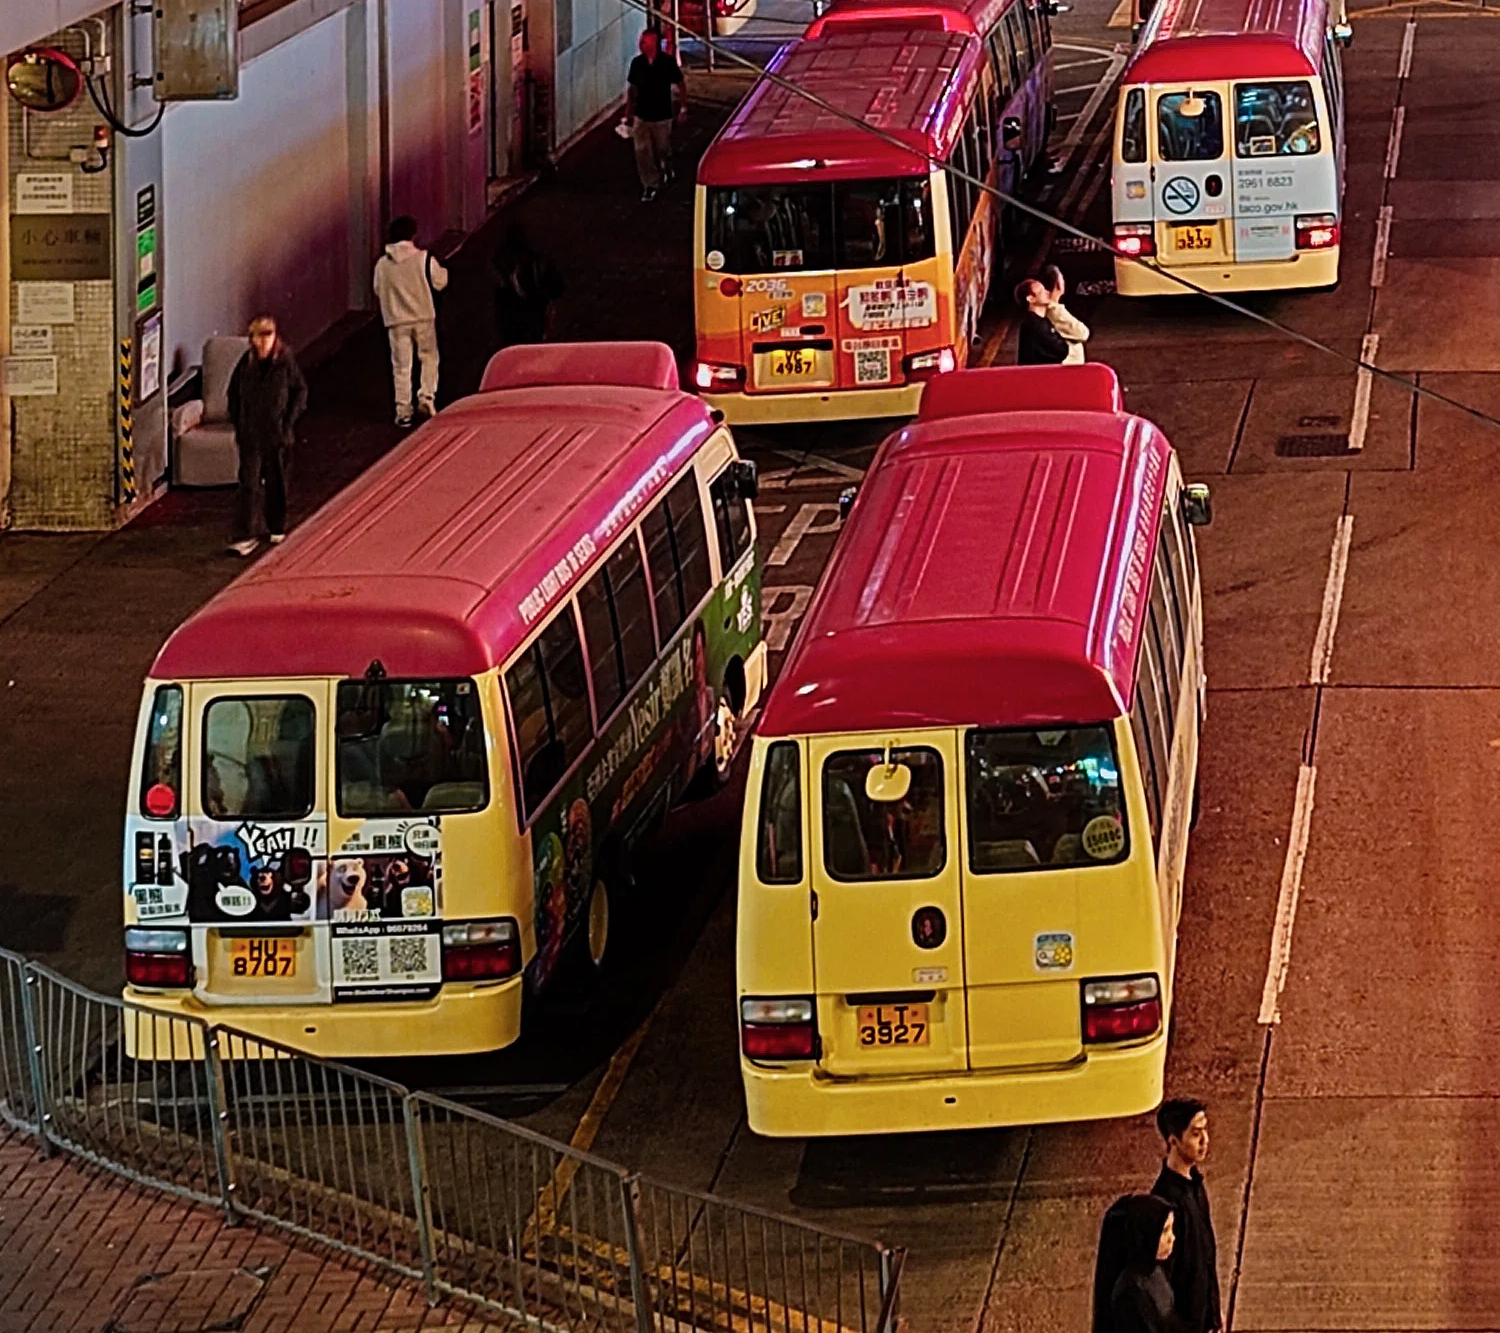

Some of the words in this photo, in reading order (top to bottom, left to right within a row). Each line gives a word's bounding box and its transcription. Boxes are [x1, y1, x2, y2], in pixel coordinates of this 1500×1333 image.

[776, 361, 812, 374] 4987
[236, 821, 296, 861] YEAH
[249, 939, 279, 958] HU
[233, 957, 293, 976] 8707
[876, 1006, 907, 1025] LT
[860, 1025, 926, 1045] 3927
